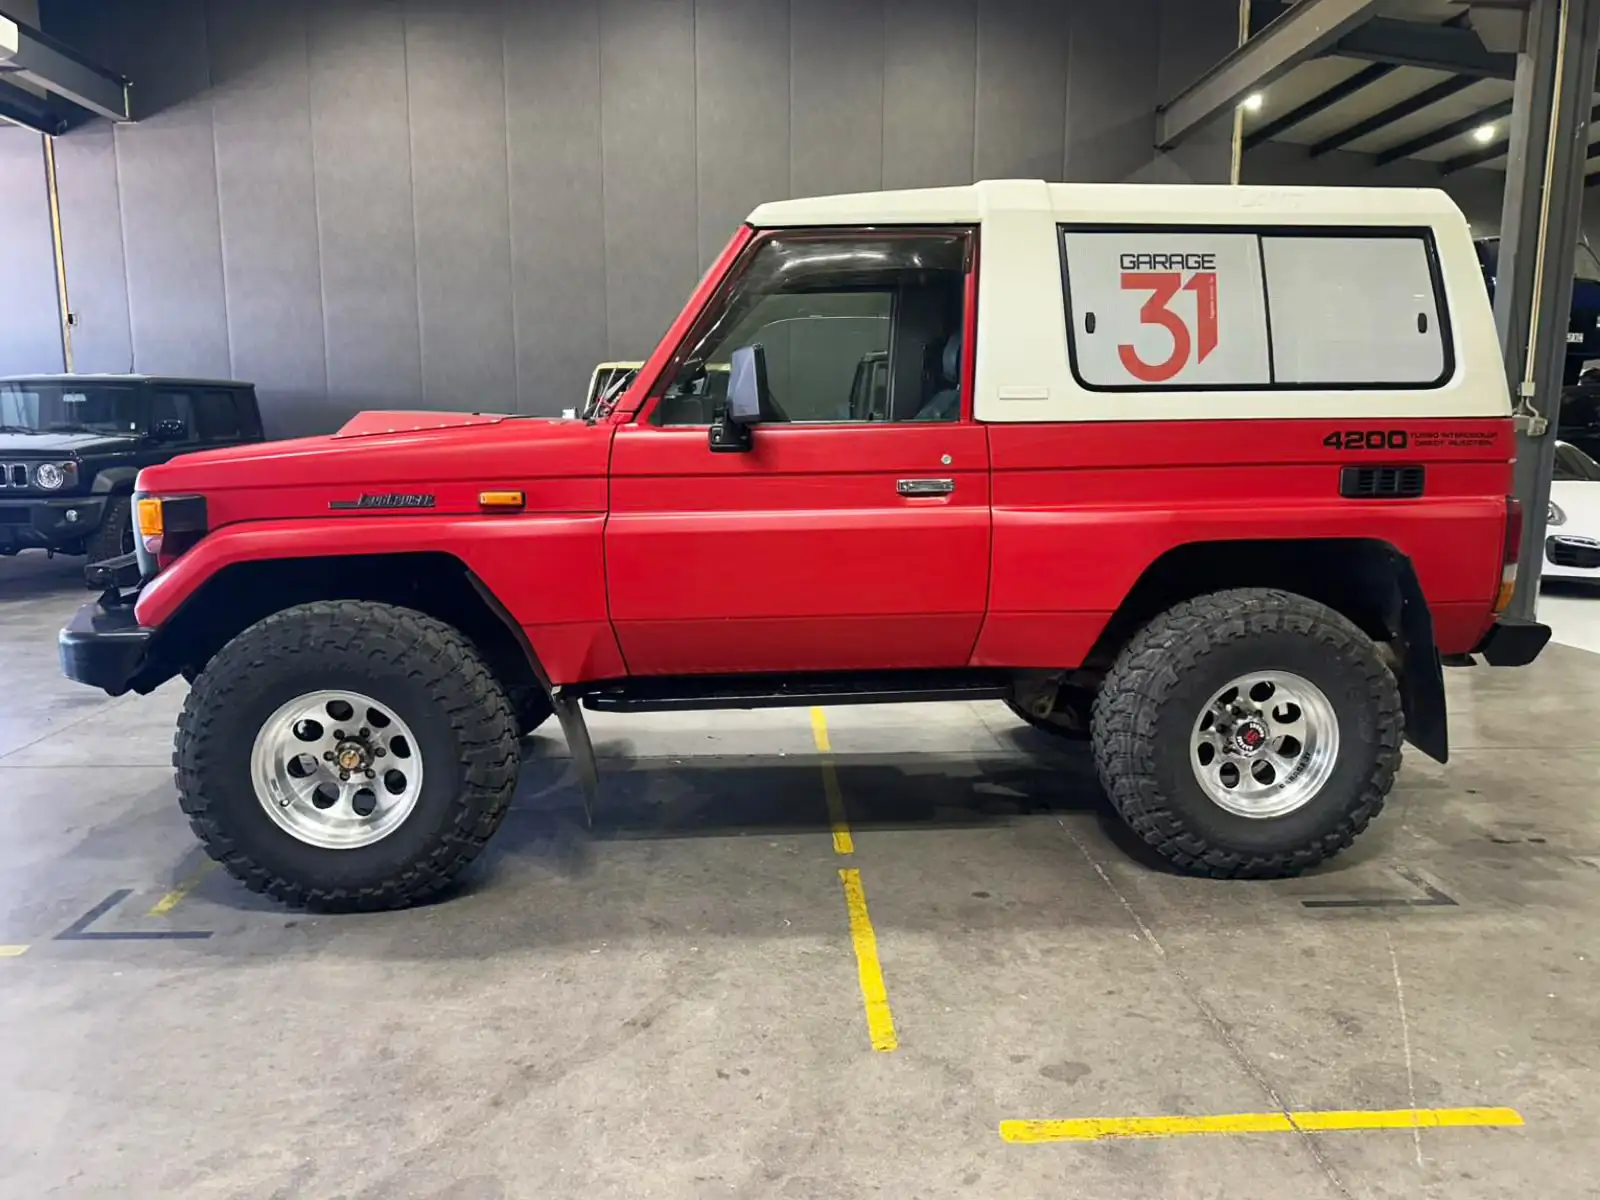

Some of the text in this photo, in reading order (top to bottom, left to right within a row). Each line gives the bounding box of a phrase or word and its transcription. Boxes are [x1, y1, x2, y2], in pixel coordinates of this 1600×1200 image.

[1120, 253, 1216, 270] GARAGE
[1117, 272, 1218, 382] 31
[1322, 430, 1408, 450] 4200
